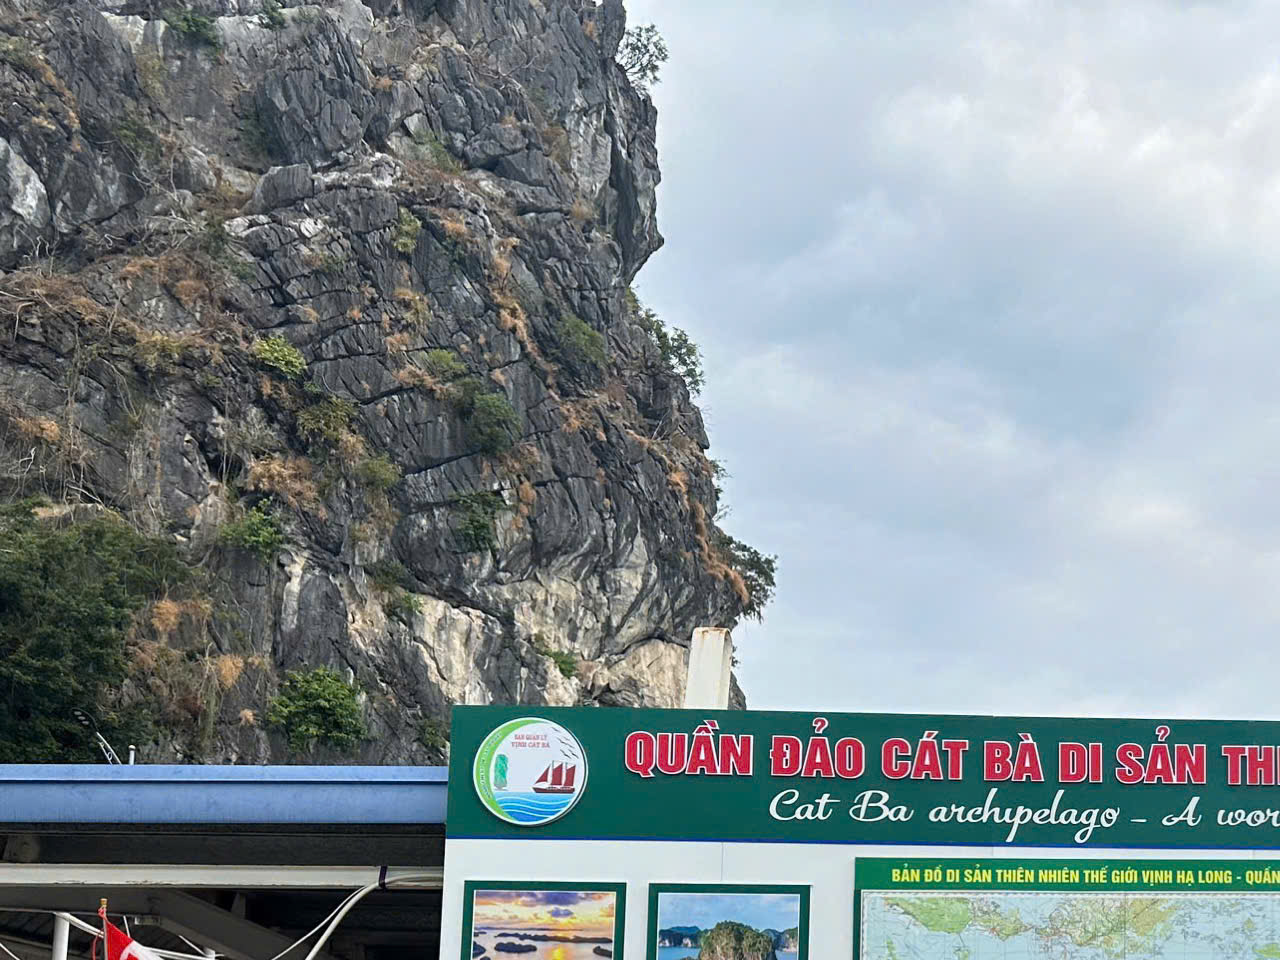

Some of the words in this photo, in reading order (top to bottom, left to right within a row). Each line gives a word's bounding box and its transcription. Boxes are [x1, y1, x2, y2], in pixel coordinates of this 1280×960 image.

[624, 720, 753, 778] QUẦN
[770, 718, 865, 778] ĐẢO
[881, 731, 969, 780] CÁT
[984, 733, 1044, 782] BÀ
[1058, 742, 1102, 783] DI
[1115, 726, 1206, 784] SẢN
[769, 789, 840, 821] Cat
[849, 789, 913, 822] Ba
[928, 788, 1120, 843] archipelago
[1161, 796, 1201, 827] A
[892, 863, 920, 882] BẢN
[924, 864, 942, 882] ĐỒ
[946, 868, 960, 882] DI
[964, 863, 992, 883] SẢN
[995, 866, 1034, 883] THIÊN
[1038, 866, 1080, 883] NHIÊN
[1083, 865, 1108, 883] THẾ
[1111, 866, 1138, 883] GIỚI
[1142, 870, 1173, 887] VỊNH
[1176, 870, 1195, 887] HẠ
[1198, 870, 1232, 884] LONG
